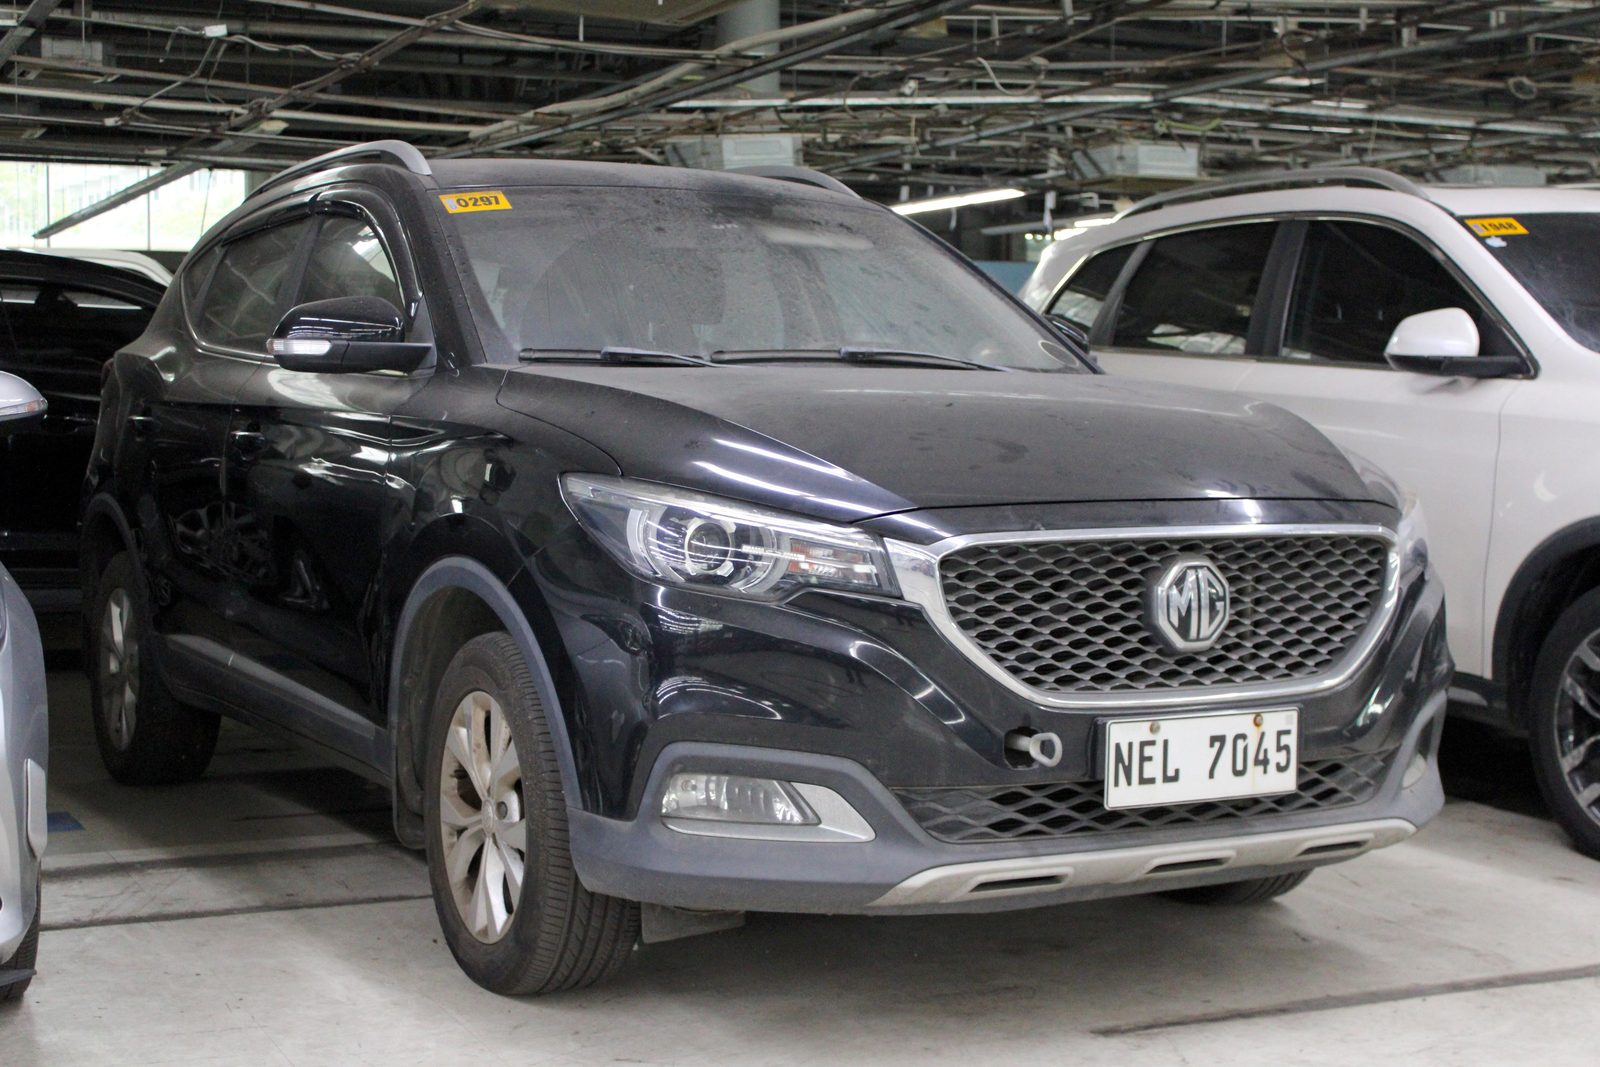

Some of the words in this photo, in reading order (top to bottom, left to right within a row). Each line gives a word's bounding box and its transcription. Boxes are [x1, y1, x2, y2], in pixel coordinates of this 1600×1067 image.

[456, 195, 501, 208] 0297
[1168, 565, 1225, 641] MG
[1114, 738, 1180, 788] NEL
[1208, 729, 1292, 780] 7045
